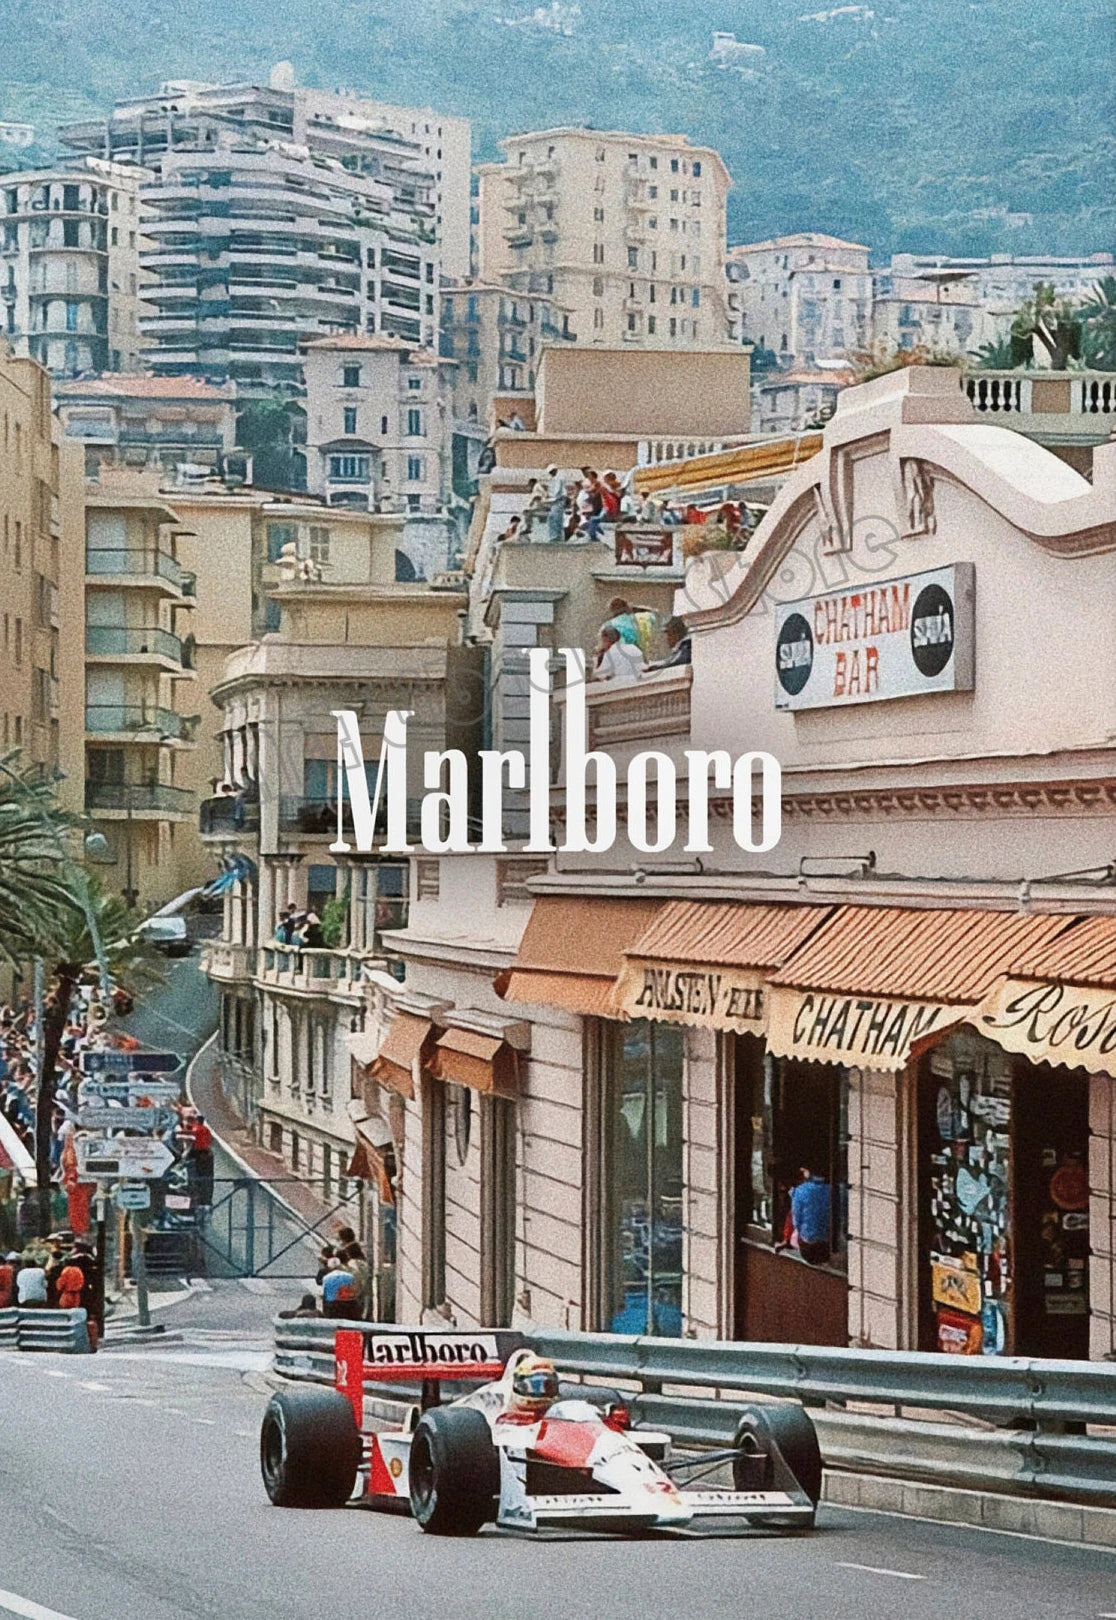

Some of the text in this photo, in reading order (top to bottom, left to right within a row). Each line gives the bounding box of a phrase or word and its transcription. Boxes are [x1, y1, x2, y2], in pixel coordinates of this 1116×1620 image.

[814, 583, 911, 645] CHATHAM
[833, 646, 879, 697] BAR
[792, 994, 943, 1057] CHATHAM
